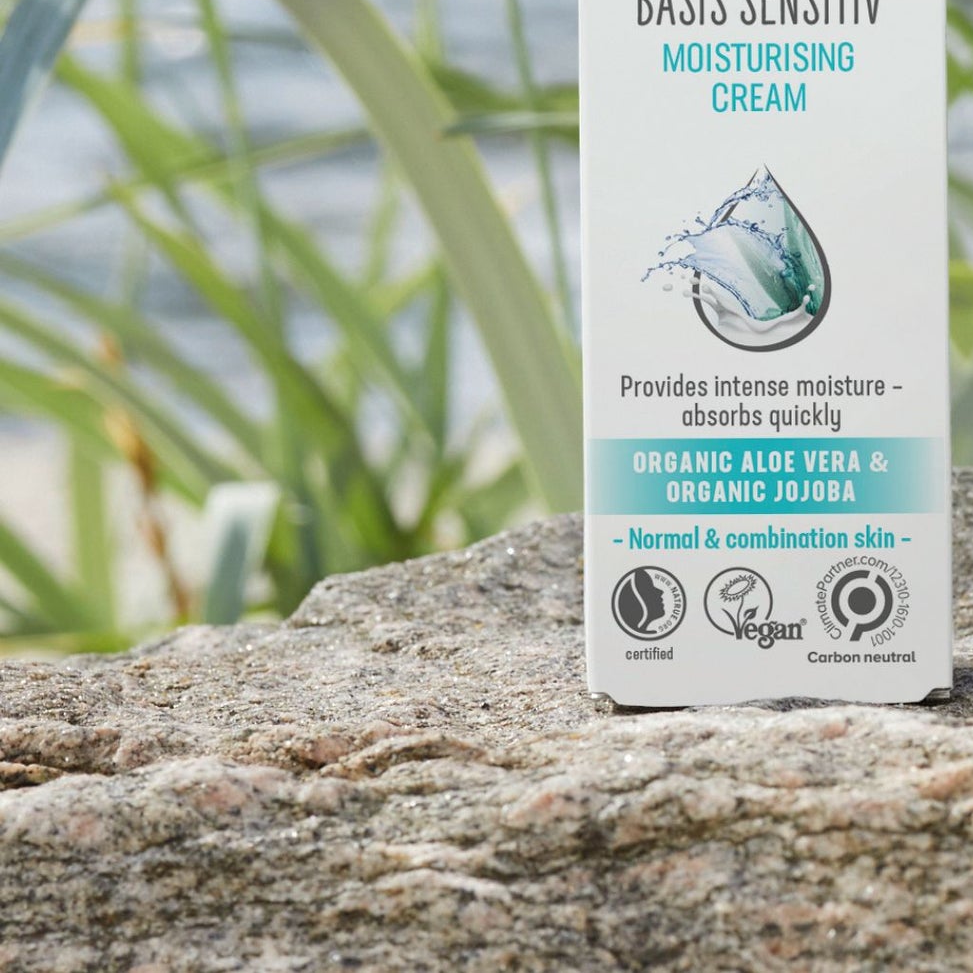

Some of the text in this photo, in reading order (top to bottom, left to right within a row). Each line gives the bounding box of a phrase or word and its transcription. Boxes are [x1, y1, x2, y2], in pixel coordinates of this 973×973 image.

[662, 41, 855, 74] MOISTURISING
[711, 82, 807, 113] CREAM
[620, 372, 708, 398] Provides
[714, 375, 789, 397] intense
[796, 374, 886, 397] moisture
[682, 401, 841, 433] absorbs quickly
[632, 449, 889, 474] ORGANIC ALOE VERA &
[666, 479, 856, 503] ORGANIC JOJOBA
[628, 525, 700, 550] Normal
[704, 527, 721, 550] &
[725, 524, 849, 550] combination
[853, 524, 895, 549] skin
[625, 646, 674, 661] certified
[807, 650, 917, 664] Carbon neutral
